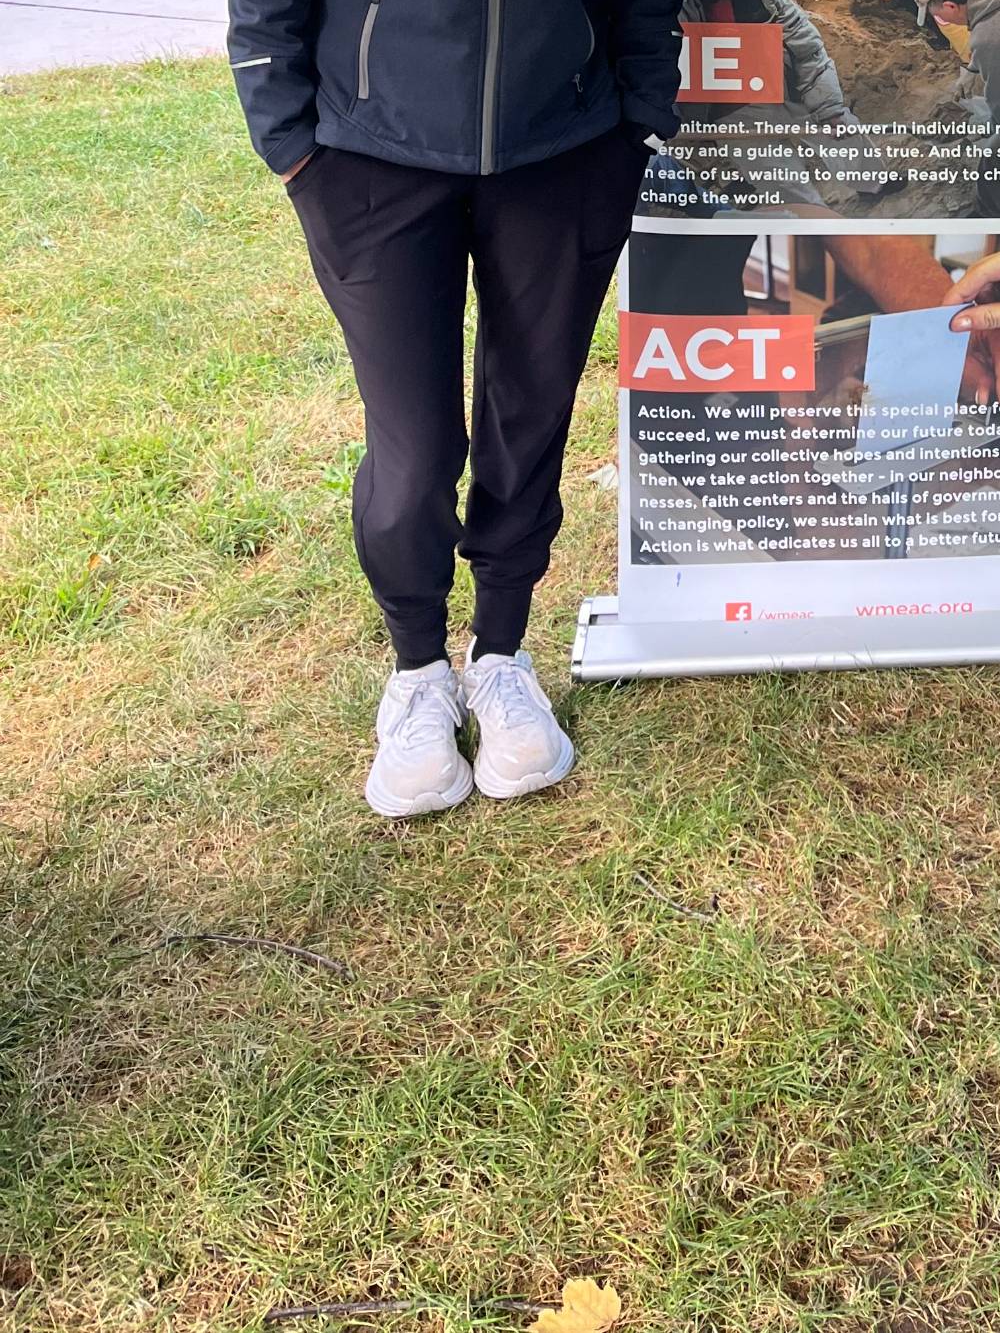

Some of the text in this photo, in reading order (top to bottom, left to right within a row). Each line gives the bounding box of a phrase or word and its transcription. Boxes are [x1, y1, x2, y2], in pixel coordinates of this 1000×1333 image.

[658, 146, 694, 160] ergy
[698, 144, 728, 157] and
[733, 147, 741, 157] a
[746, 144, 793, 160] guide
[797, 144, 814, 158] to
[819, 144, 859, 160] keep
[863, 147, 881, 157] us
[885, 145, 924, 158] true.
[928, 144, 961, 158] And
[965, 144, 992, 158] the
[658, 167, 695, 180] each
[699, 167, 717, 180] of
[721, 170, 744, 182] us,
[748, 167, 809, 183] waiting
[814, 168, 831, 181] to
[836, 170, 903, 184] emerge.
[907, 167, 958, 184] Ready
[962, 168, 979, 181] to
[640, 188, 784, 206] change the world.
[632, 327, 797, 381] ACT.
[638, 428, 710, 443] succeed,
[715, 430, 739, 441] we
[744, 427, 786, 440] must
[790, 426, 877, 441] determine
[880, 426, 909, 440] our
[913, 426, 962, 437] future
[638, 451, 716, 467] gathering
[720, 452, 748, 464] our
[751, 448, 830, 463] collective
[833, 448, 882, 463] hopes
[885, 448, 915, 461] and
[919, 446, 1000, 460] intentions
[639, 498, 697, 509] nesses,
[701, 494, 739, 508] faith
[742, 493, 803, 507] centers
[808, 491, 837, 505] and
[840, 491, 867, 505] the
[871, 491, 907, 504] halls
[911, 490, 929, 504] of
[639, 517, 654, 530] in
[658, 517, 732, 532] changing
[736, 514, 789, 532] policy,
[792, 516, 817, 527] we
[821, 513, 878, 526] sustain
[881, 513, 922, 526] what
[926, 511, 938, 524] is
[942, 510, 977, 523] best
[639, 539, 692, 553] Action
[696, 539, 709, 552] is
[713, 538, 754, 551] what
[757, 535, 836, 550] dedicates
[840, 538, 857, 548] us
[862, 534, 880, 548] all
[883, 535, 901, 547] to
[906, 537, 913, 546] a
[918, 533, 968, 546] better
